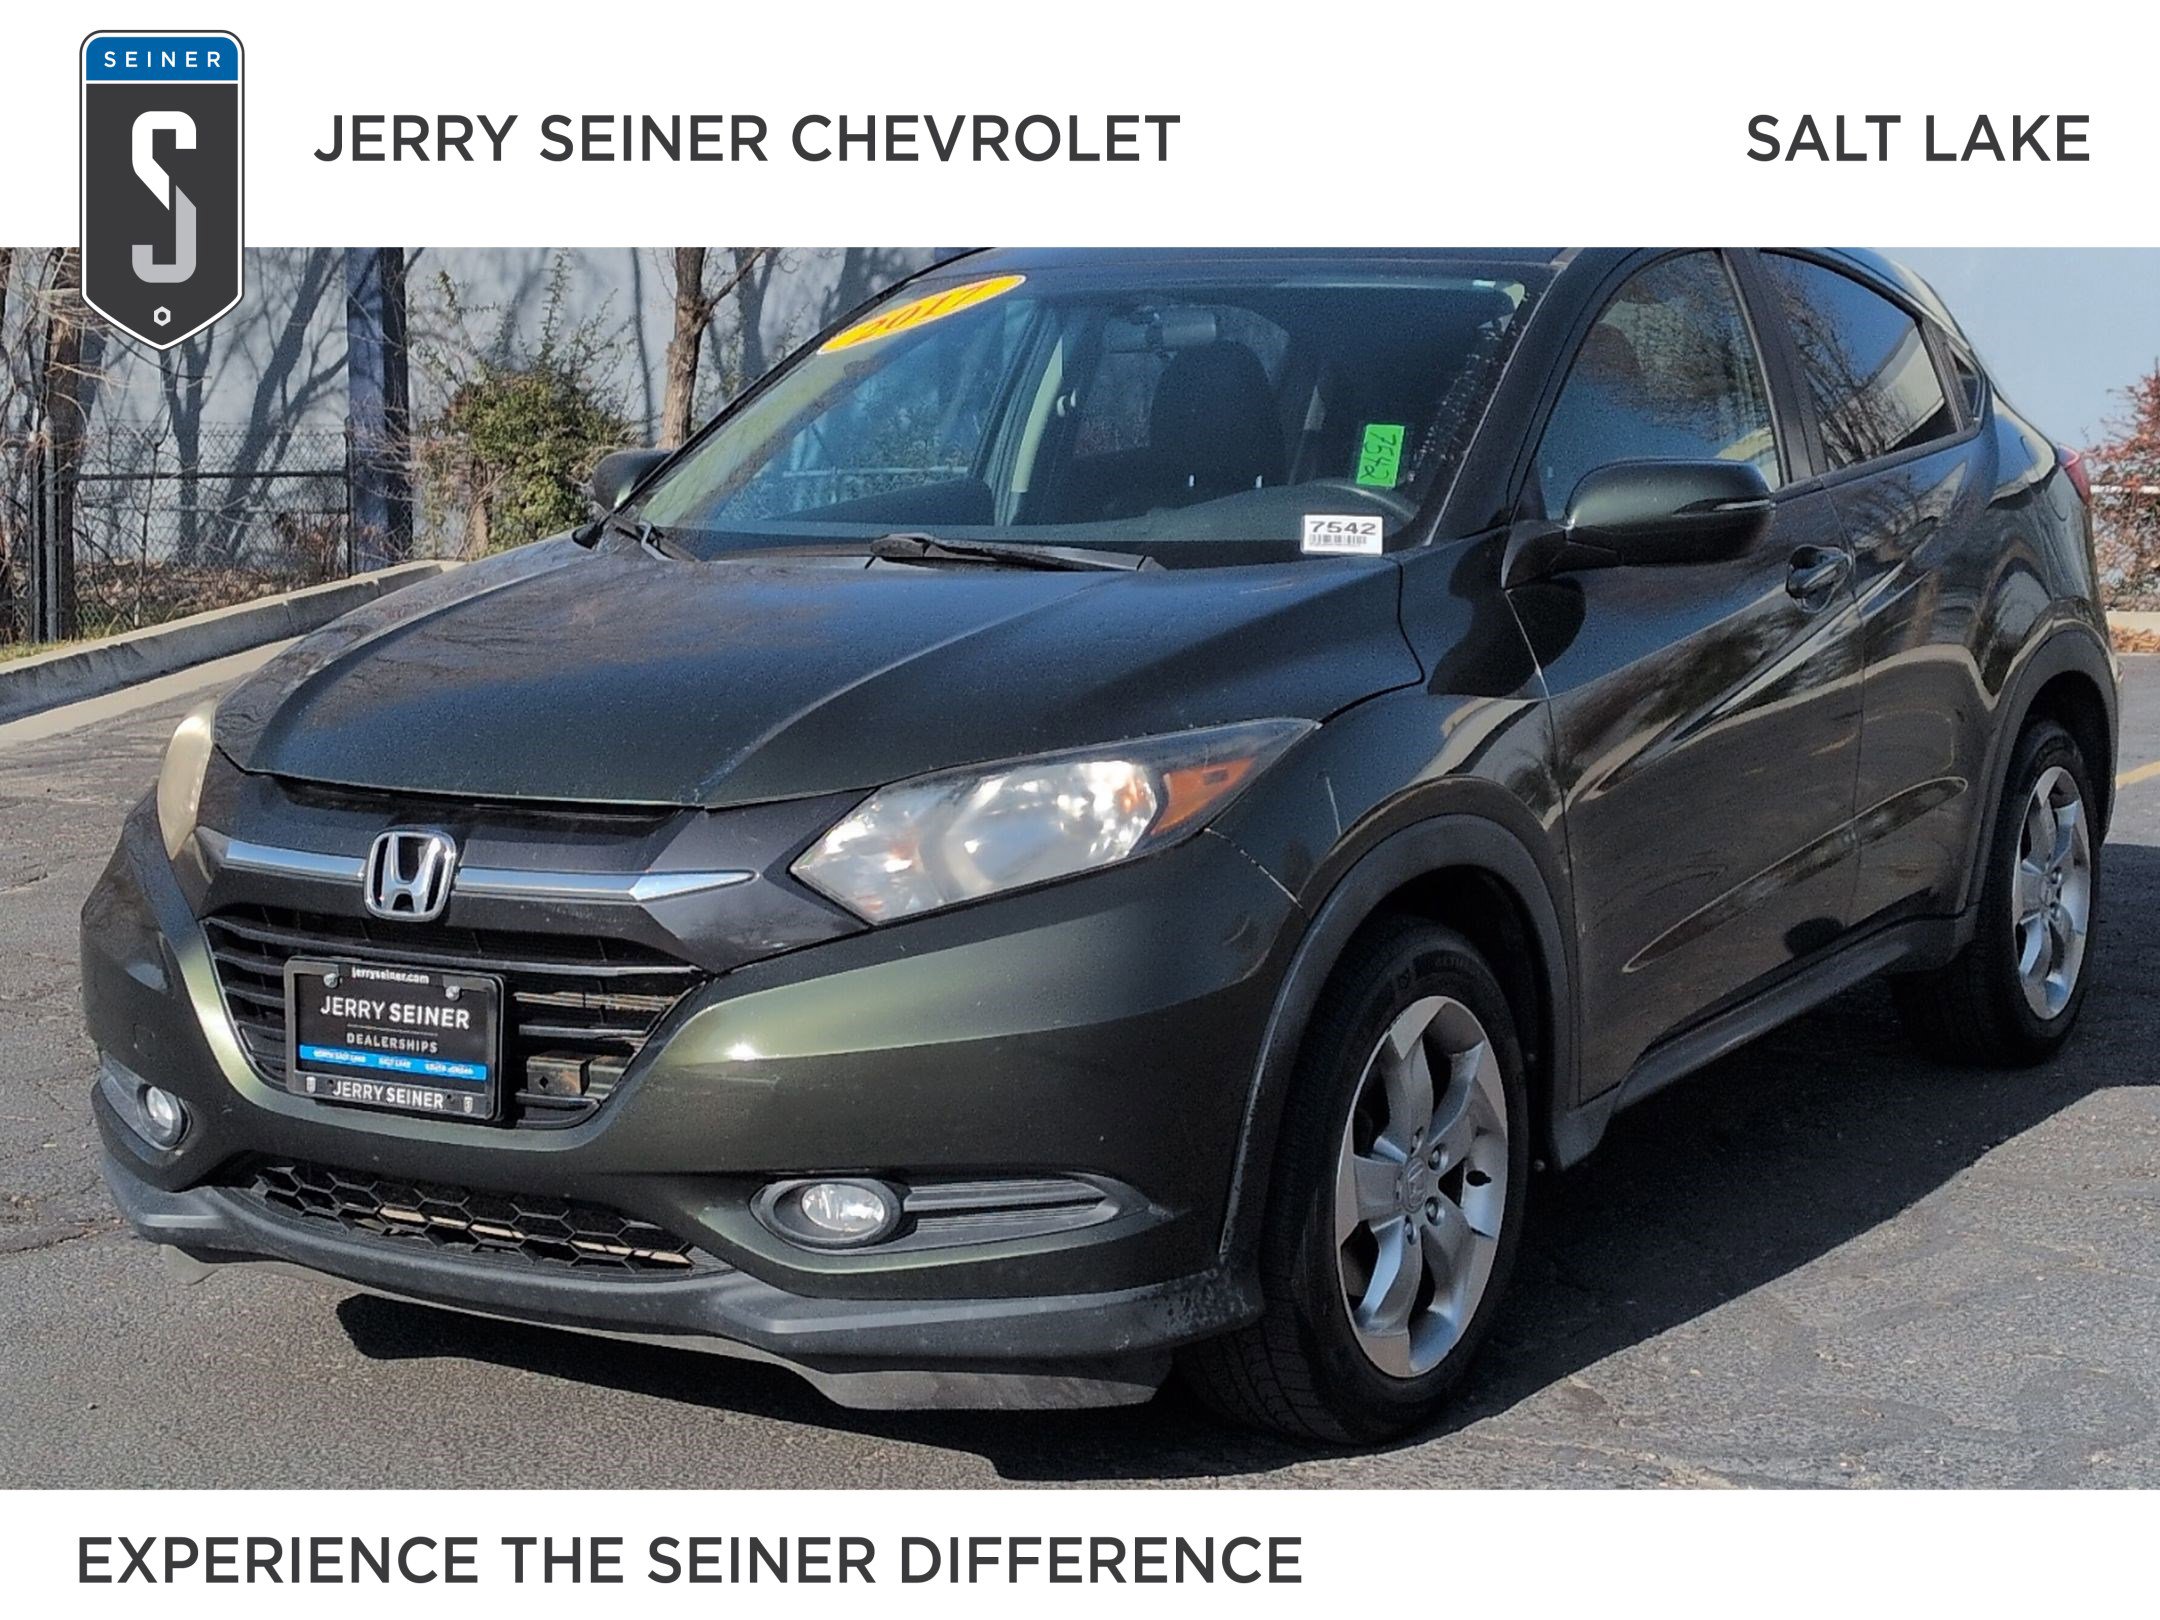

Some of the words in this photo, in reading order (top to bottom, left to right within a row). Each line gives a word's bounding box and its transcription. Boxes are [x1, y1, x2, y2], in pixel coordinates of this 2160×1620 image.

[1360, 432, 1397, 482] 7542
[1310, 520, 1376, 535] 7542
[320, 996, 386, 1021] JERRY
[389, 1003, 470, 1030] SEINER
[346, 1032, 439, 1054] DEALERSHIPS
[333, 1080, 386, 1100] JERRY
[387, 1087, 444, 1109] SEINER
